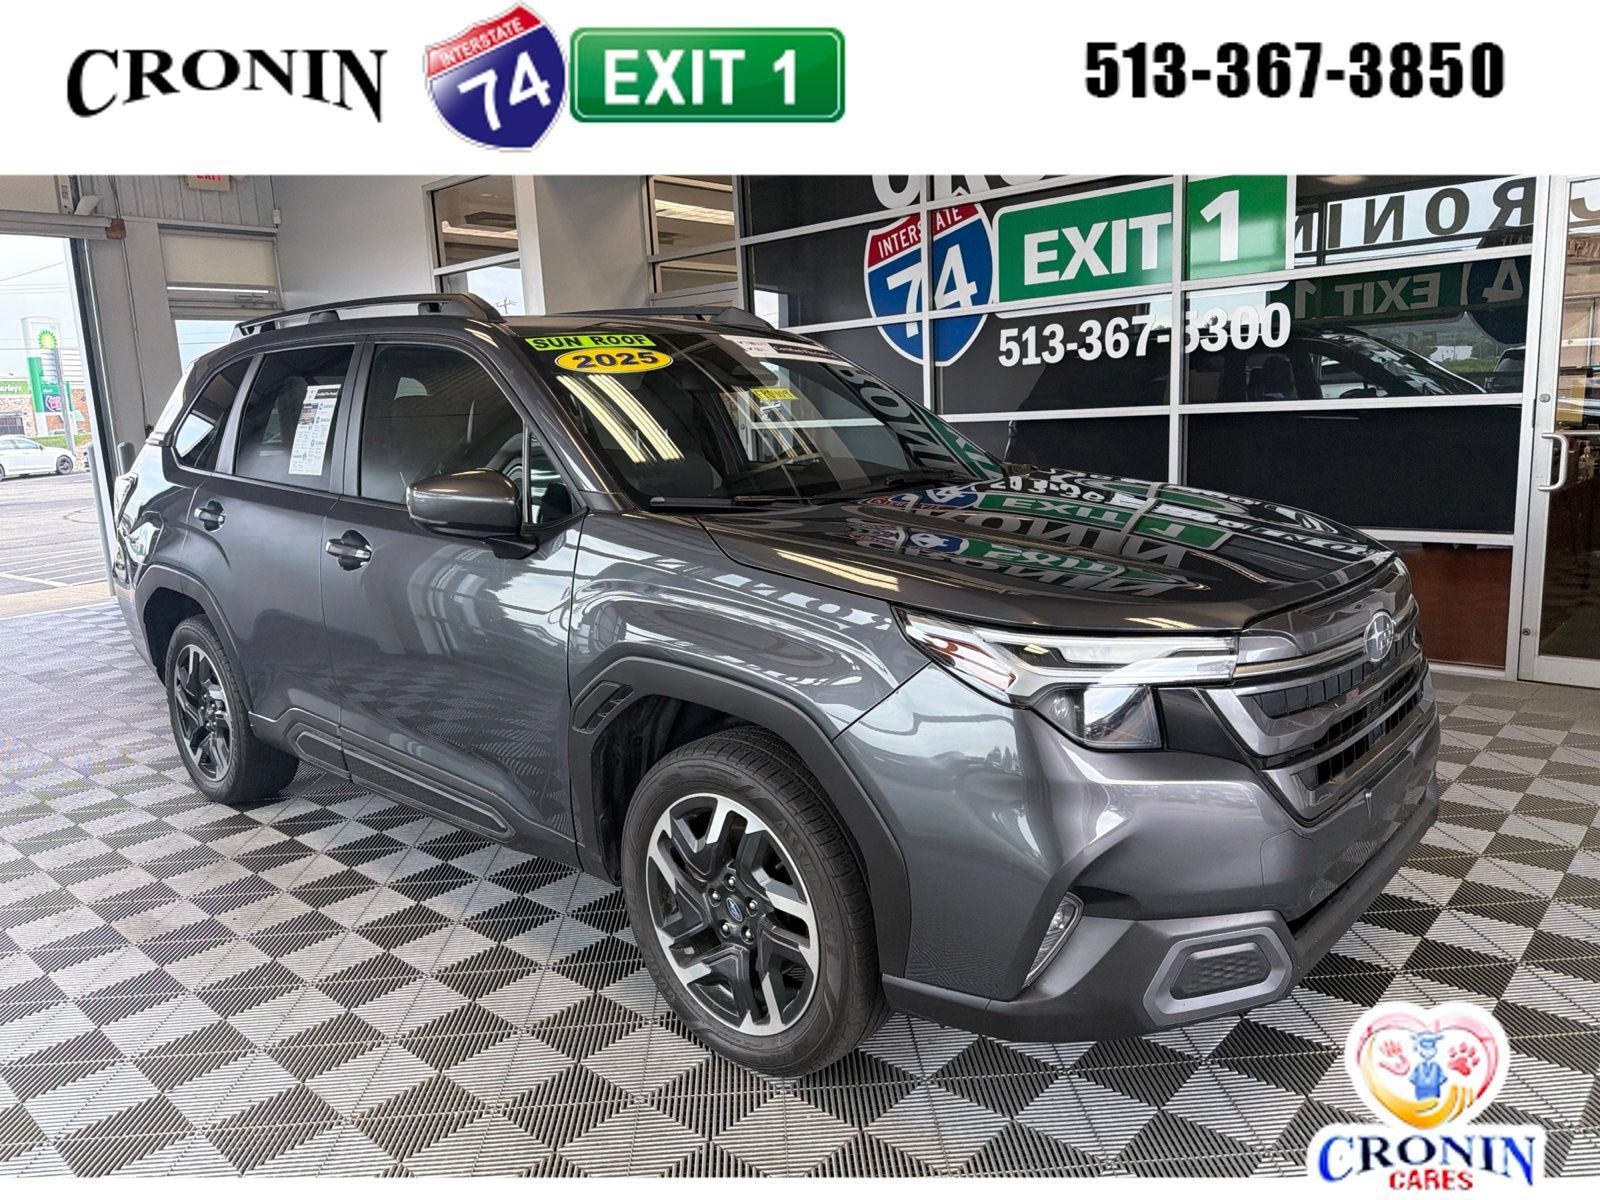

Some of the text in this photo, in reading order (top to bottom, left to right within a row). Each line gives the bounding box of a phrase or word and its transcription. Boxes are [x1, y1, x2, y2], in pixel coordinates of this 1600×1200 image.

[878, 206, 963, 259] INTERATE
[1024, 189, 1240, 286] EXIT 1
[886, 243, 978, 339] 74
[532, 335, 649, 349] SUN ROOF
[572, 351, 659, 369] 2025
